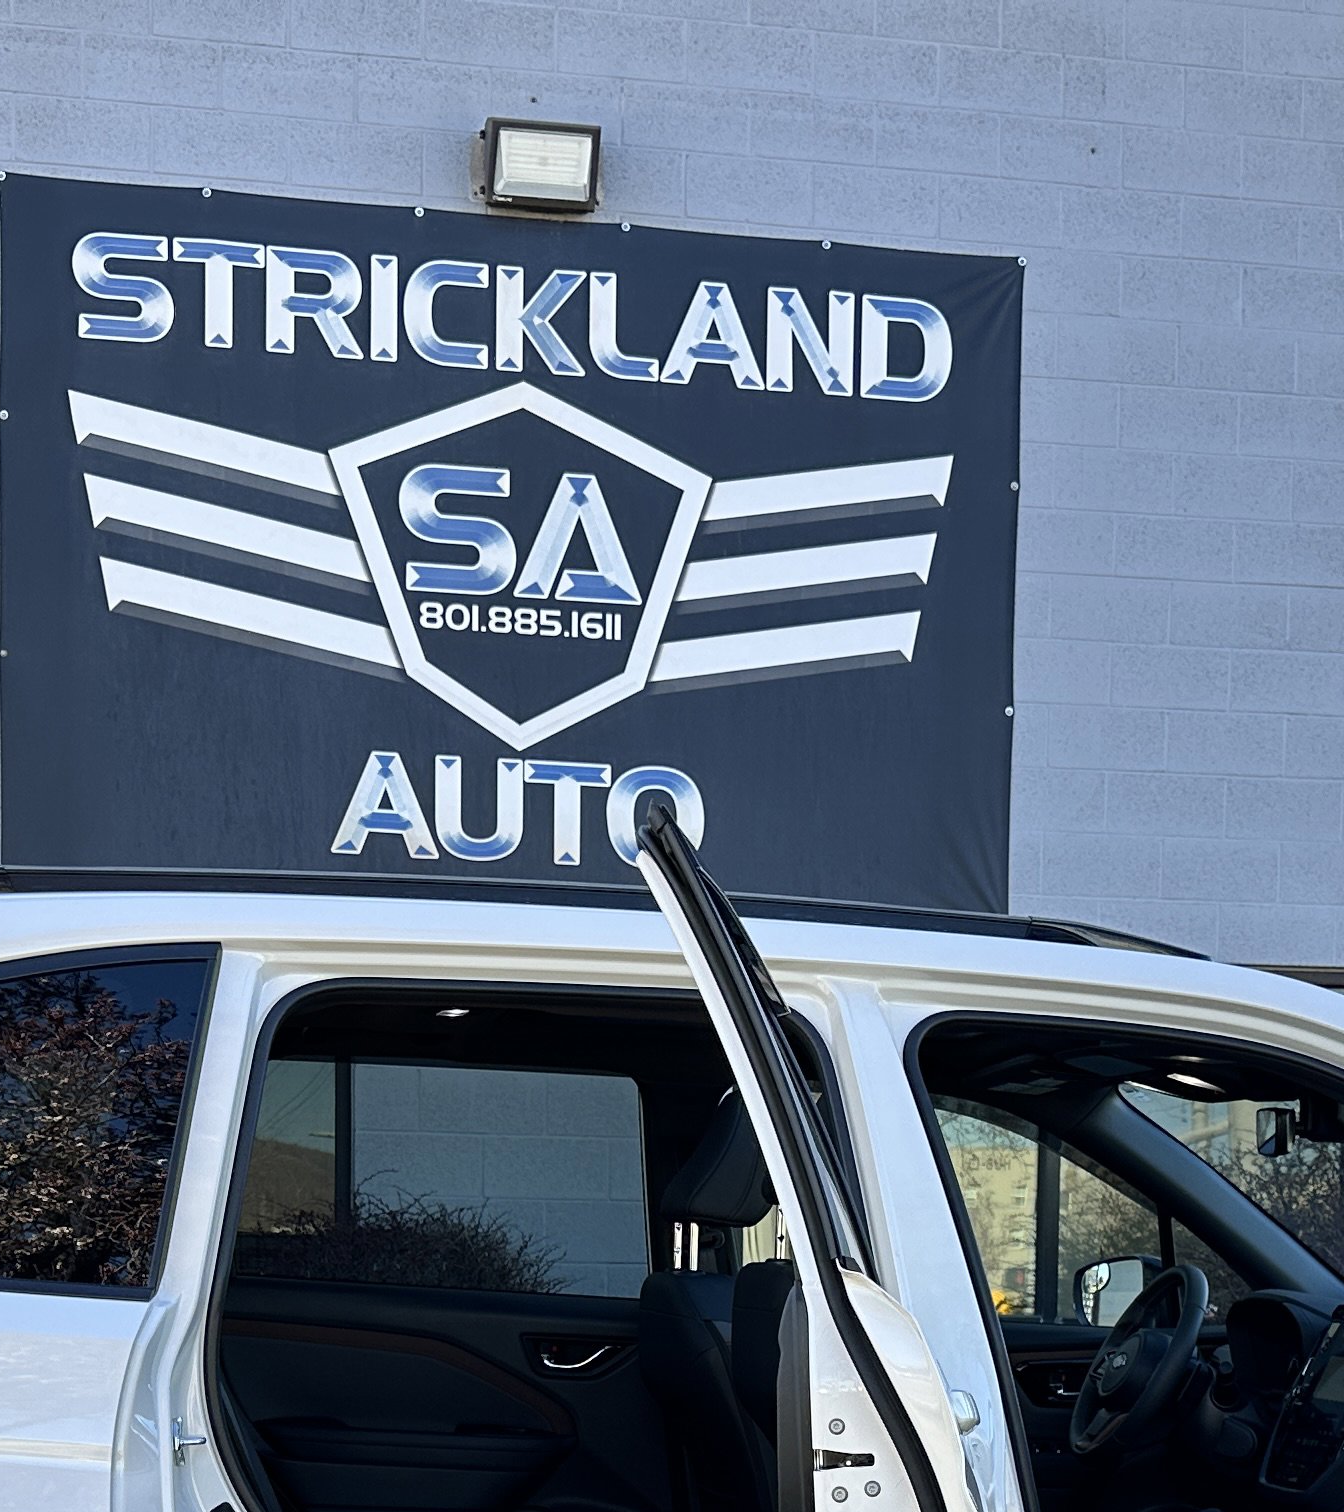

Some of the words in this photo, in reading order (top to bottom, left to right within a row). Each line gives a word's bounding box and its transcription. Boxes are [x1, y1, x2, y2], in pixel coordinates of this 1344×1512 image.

[71, 231, 954, 402] STRICKLAND
[397, 464, 643, 605] SA
[419, 602, 623, 641] 801.885.1611
[330, 750, 704, 867] AUTO
